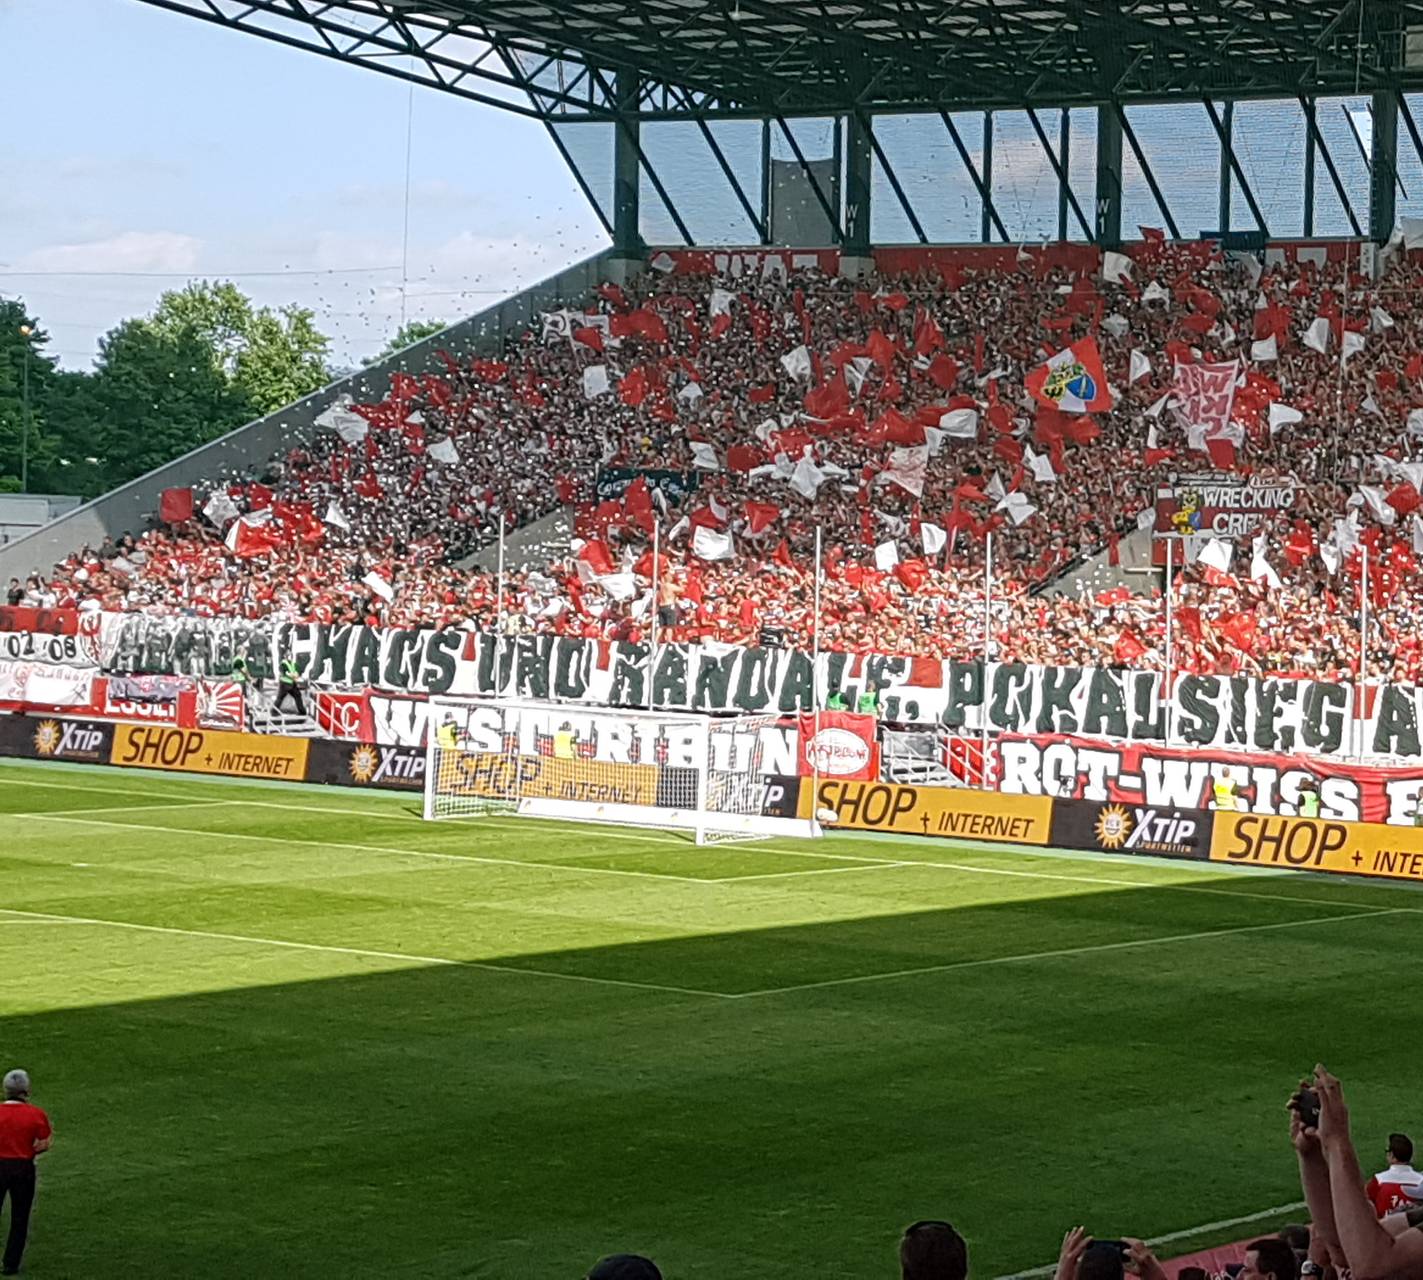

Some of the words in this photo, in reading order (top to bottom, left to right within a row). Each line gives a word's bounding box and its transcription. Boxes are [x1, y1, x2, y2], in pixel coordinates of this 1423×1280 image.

[1201, 486, 1296, 509] WRECKING
[1212, 512, 1259, 536] CRE
[477, 633, 591, 700] UND
[941, 656, 1348, 754] POKALSIEG
[123, 726, 204, 766] SHOP
[218, 753, 295, 776] INTERNET
[818, 781, 917, 828] SHOP
[938, 811, 1035, 839] INTERNET
[1227, 815, 1348, 867] SHOP
